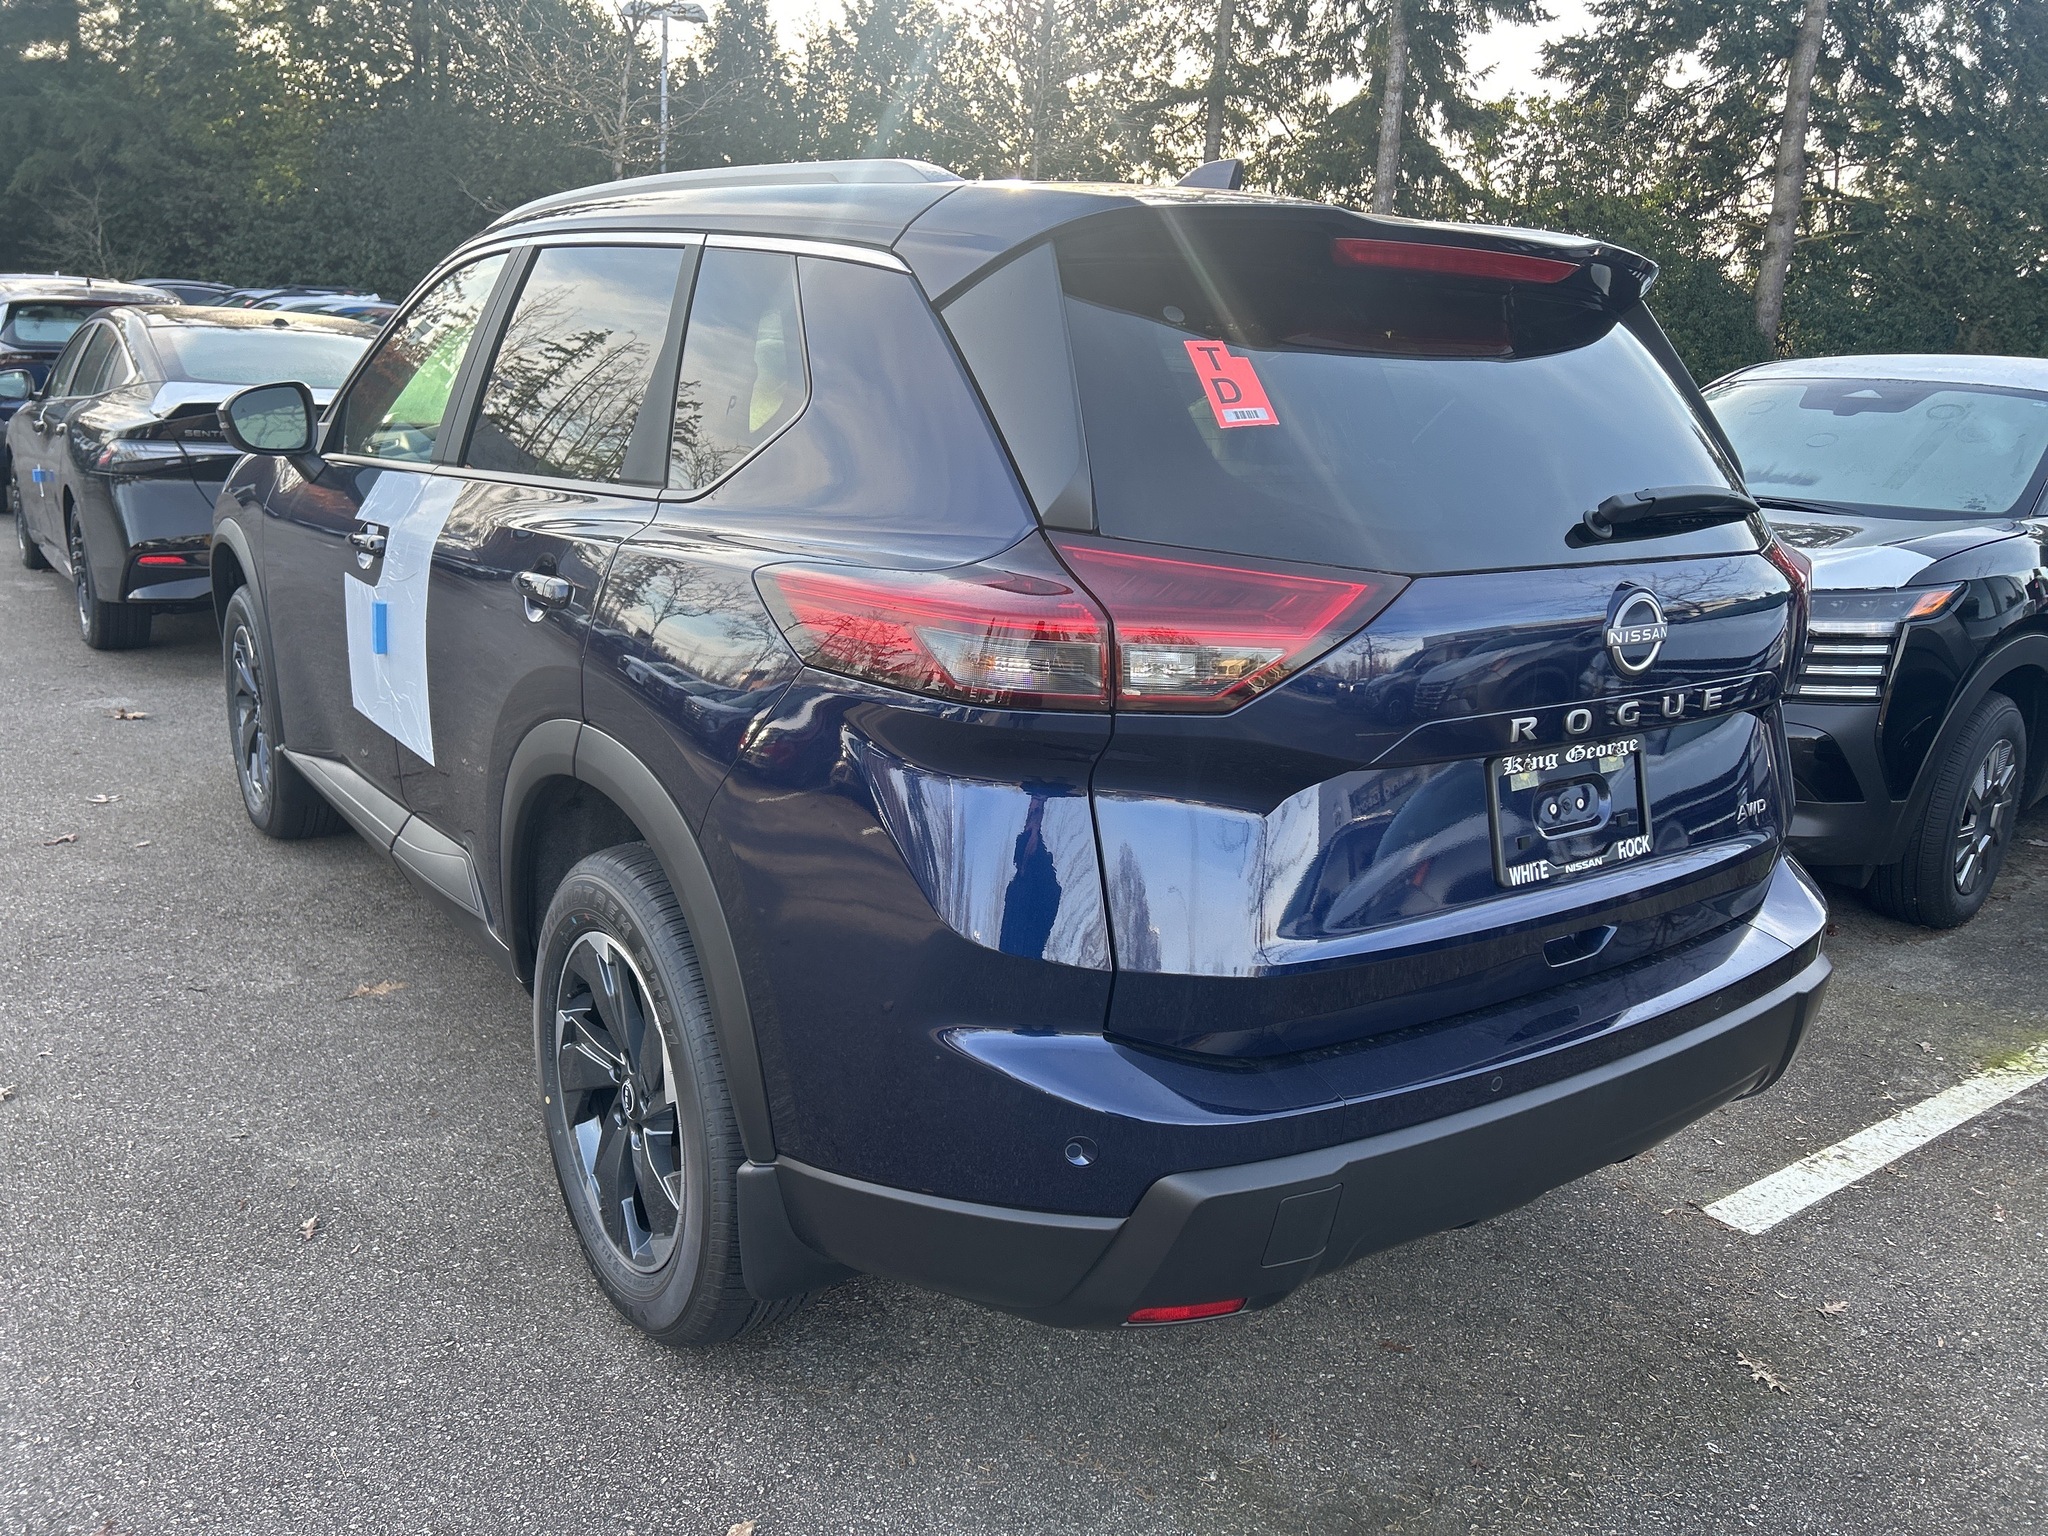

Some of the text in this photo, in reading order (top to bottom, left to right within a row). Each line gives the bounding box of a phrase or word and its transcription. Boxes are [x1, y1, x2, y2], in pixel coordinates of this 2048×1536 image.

[1197, 347, 1221, 371] T
[1211, 378, 1242, 404] D
[1610, 626, 1667, 644] NISSAN
[1510, 687, 1722, 743] ROGUE
[1502, 738, 1638, 776] King George
[1737, 799, 1766, 821] AWD
[1509, 834, 1651, 886] WHITE NISSAN ROCK
